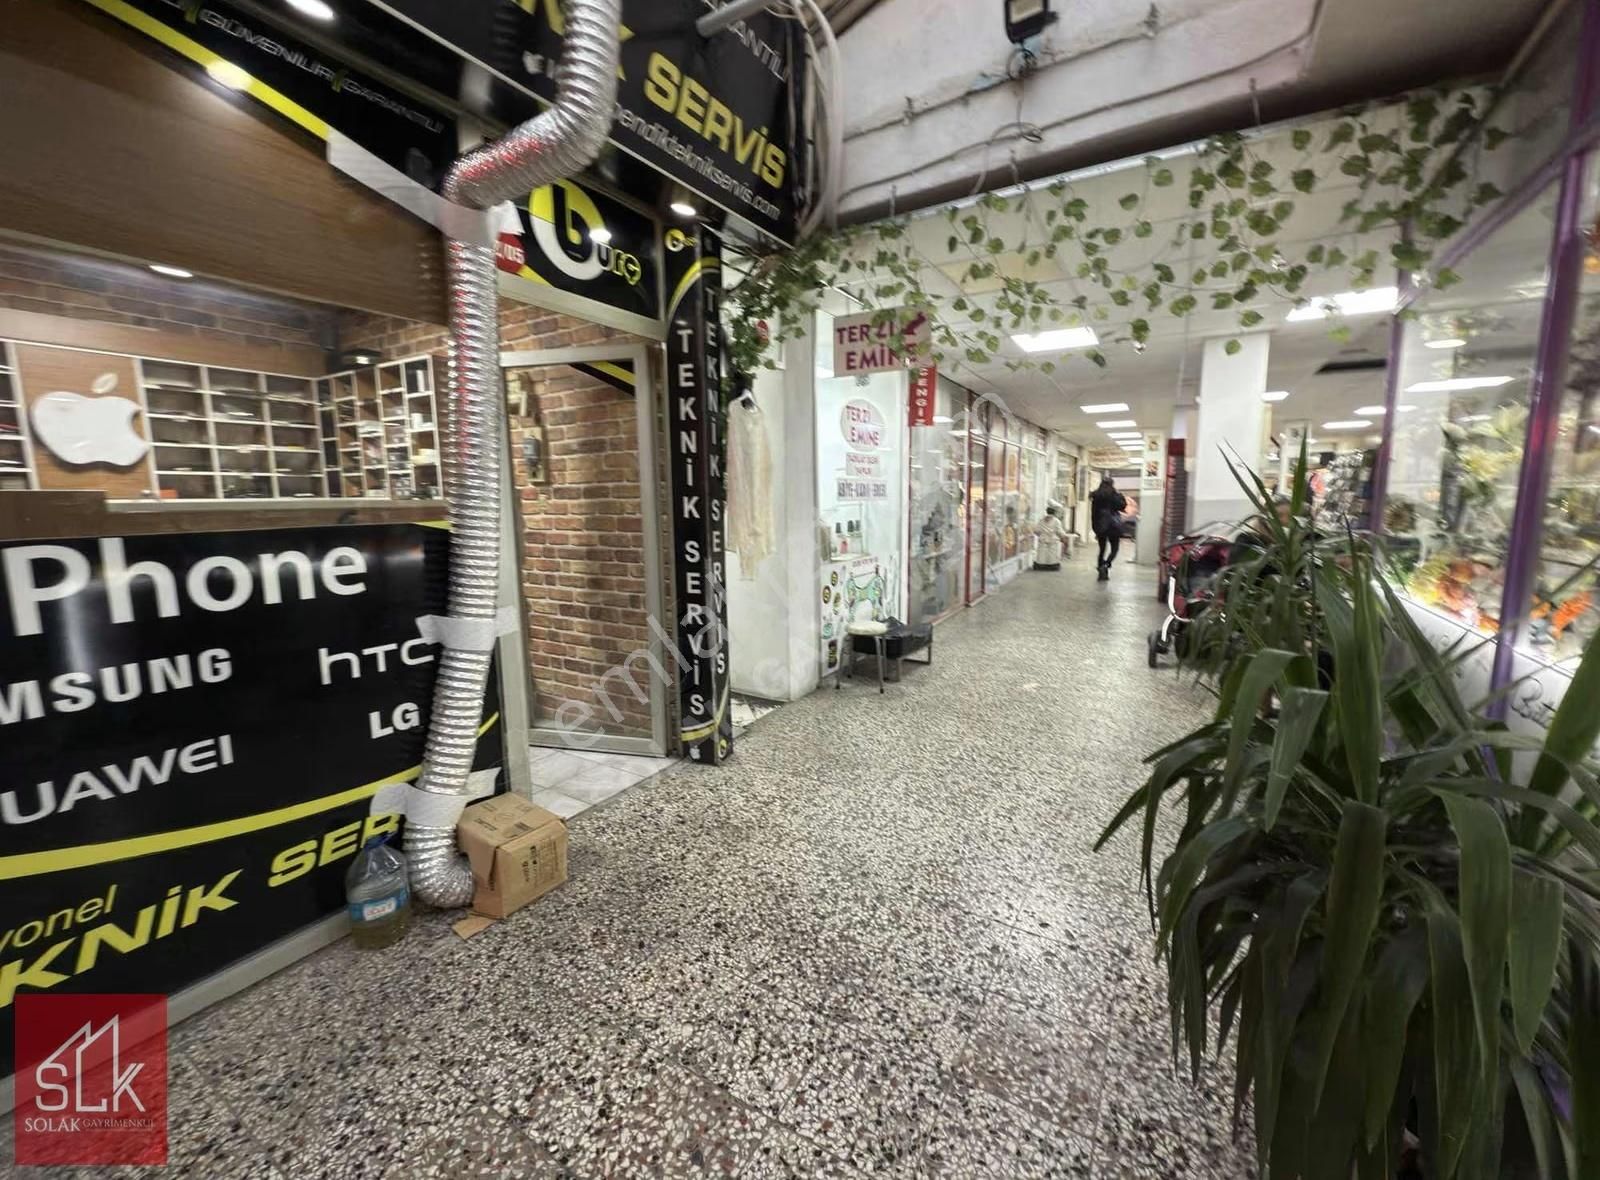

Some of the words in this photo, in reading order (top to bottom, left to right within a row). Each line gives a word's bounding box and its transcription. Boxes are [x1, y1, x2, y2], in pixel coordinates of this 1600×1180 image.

[644, 51, 787, 190] SERVİS
[676, 329, 701, 519] TEKNİK
[3, 537, 368, 636] Phone
[684, 540, 705, 716] SERVİS
[369, 702, 421, 739] LG
